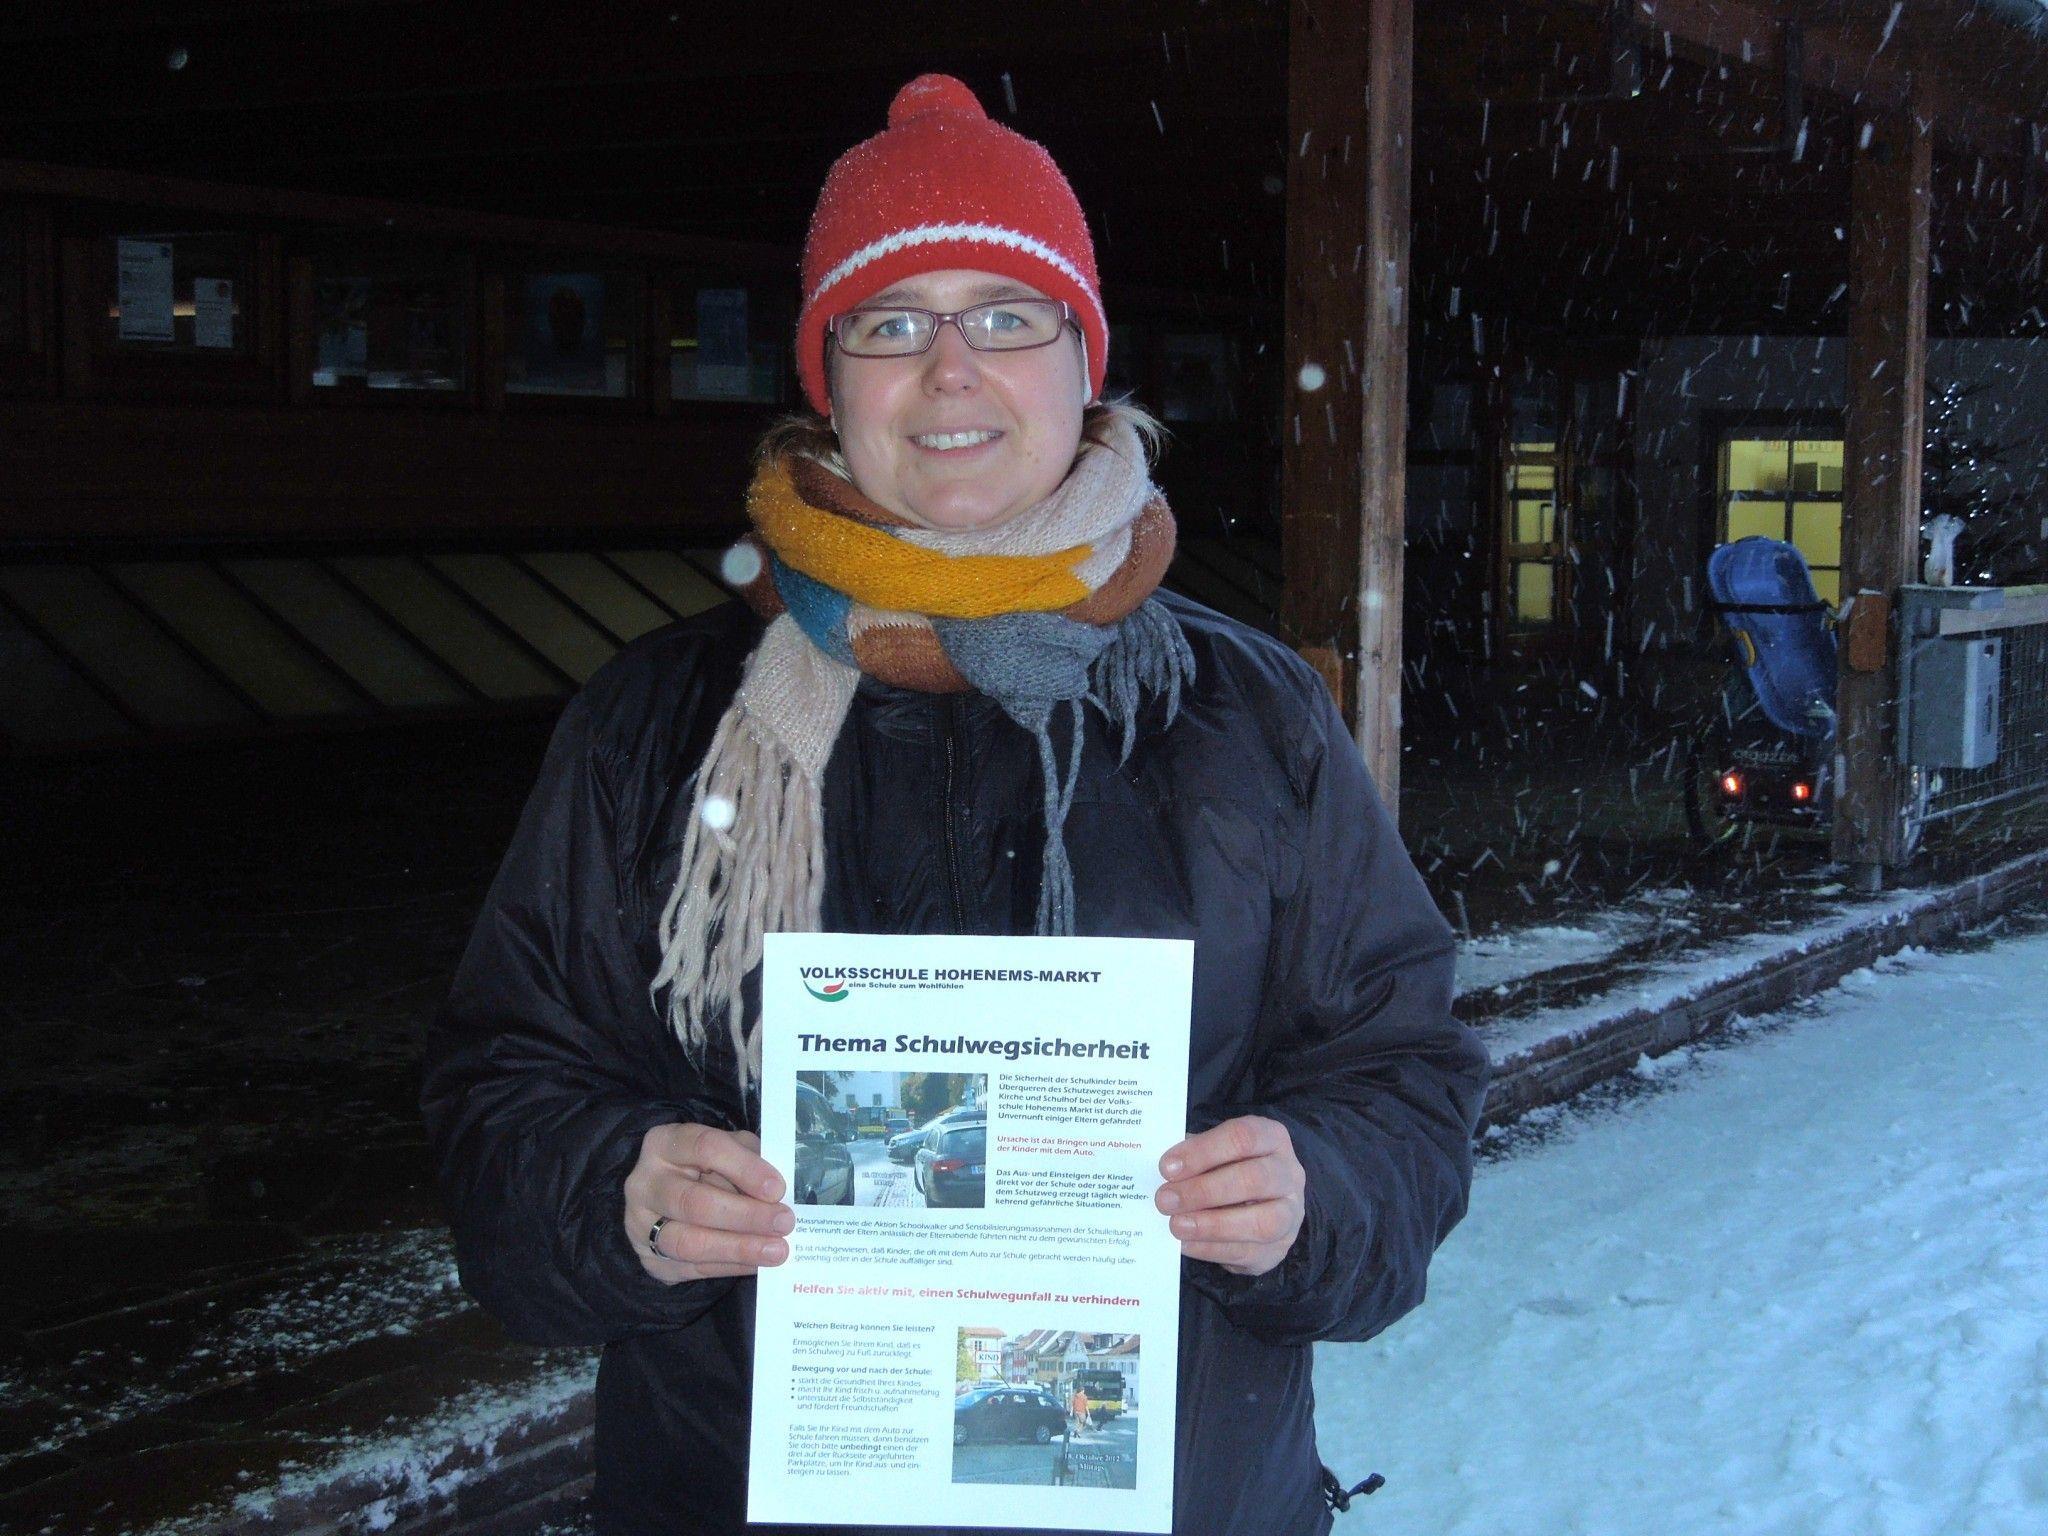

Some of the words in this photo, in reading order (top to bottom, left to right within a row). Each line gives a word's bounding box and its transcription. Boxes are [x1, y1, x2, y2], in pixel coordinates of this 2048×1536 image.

[800, 967, 928, 980] VOLKSSCHULE
[934, 969, 1101, 982] HOHENEMS-MARKT
[798, 1034, 886, 1052] Thema
[895, 1037, 1150, 1061] Schulwegsicherheit
[1014, 1074, 1053, 1082] Sicherheit
[1070, 1076, 1116, 1085] Schulkinder
[999, 1082, 1046, 1094] Überqueren
[1064, 1086, 1114, 1096] Schutzweges
[1116, 1088, 1153, 1096] zwischen
[1043, 1095, 1077, 1103] Schulhof
[1026, 1104, 1067, 1112] Hohenems
[998, 1112, 1043, 1120] Unvernunft
[1045, 1114, 1073, 1124] einiger
[997, 1135, 1030, 1143] Ursache
[1057, 1138, 1088, 1148] Bringen
[1107, 1140, 1142, 1148] Abholen
[1049, 1170, 1090, 1181] Einsteigen
[1015, 1188, 1057, 1198] Schutzweg
[1059, 1190, 1089, 1199] erzeugt
[1091, 1191, 1117, 1200] täglich
[1030, 1198, 1074, 1208] gefährliche
[1076, 1200, 1122, 1208] Situationen.
[793, 1282, 833, 1293] Helfen
[837, 1284, 854, 1294] Sie
[858, 1285, 888, 1295] aktiv
[892, 1286, 914, 1296] mit,
[919, 1287, 953, 1298] einen
[955, 1289, 1051, 1304] Schulwegunfall
[1072, 1293, 1140, 1305] verhindern
[830, 1322, 858, 1332] Beitrag
[792, 1364, 834, 1374] Bewegung
[840, 1443, 881, 1452] unbedingt
